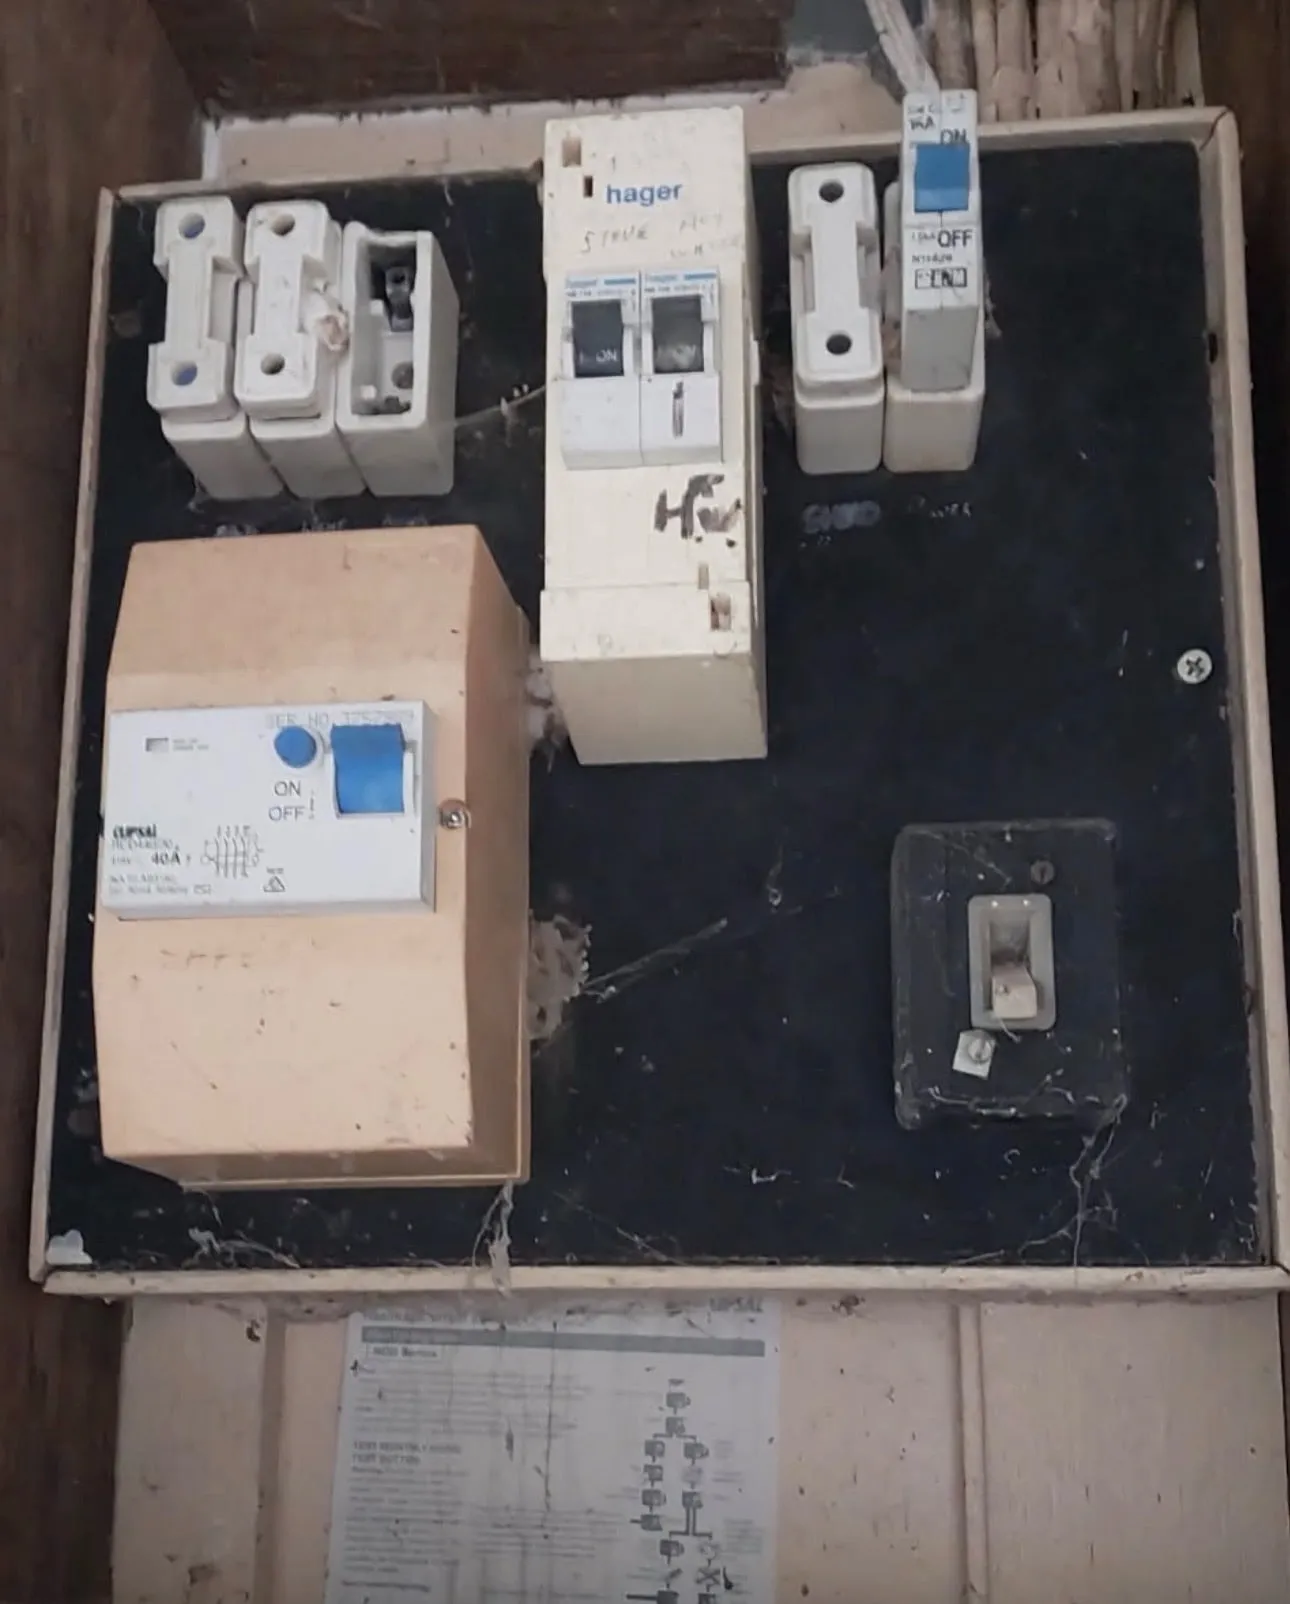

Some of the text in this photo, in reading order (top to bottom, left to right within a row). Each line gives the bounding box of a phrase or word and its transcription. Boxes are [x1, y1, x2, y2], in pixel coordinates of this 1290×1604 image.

[940, 127, 967, 144] ON
[606, 183, 682, 206] hager
[938, 229, 973, 248] OFF
[273, 779, 302, 797] ON
[268, 805, 305, 822] OFF
